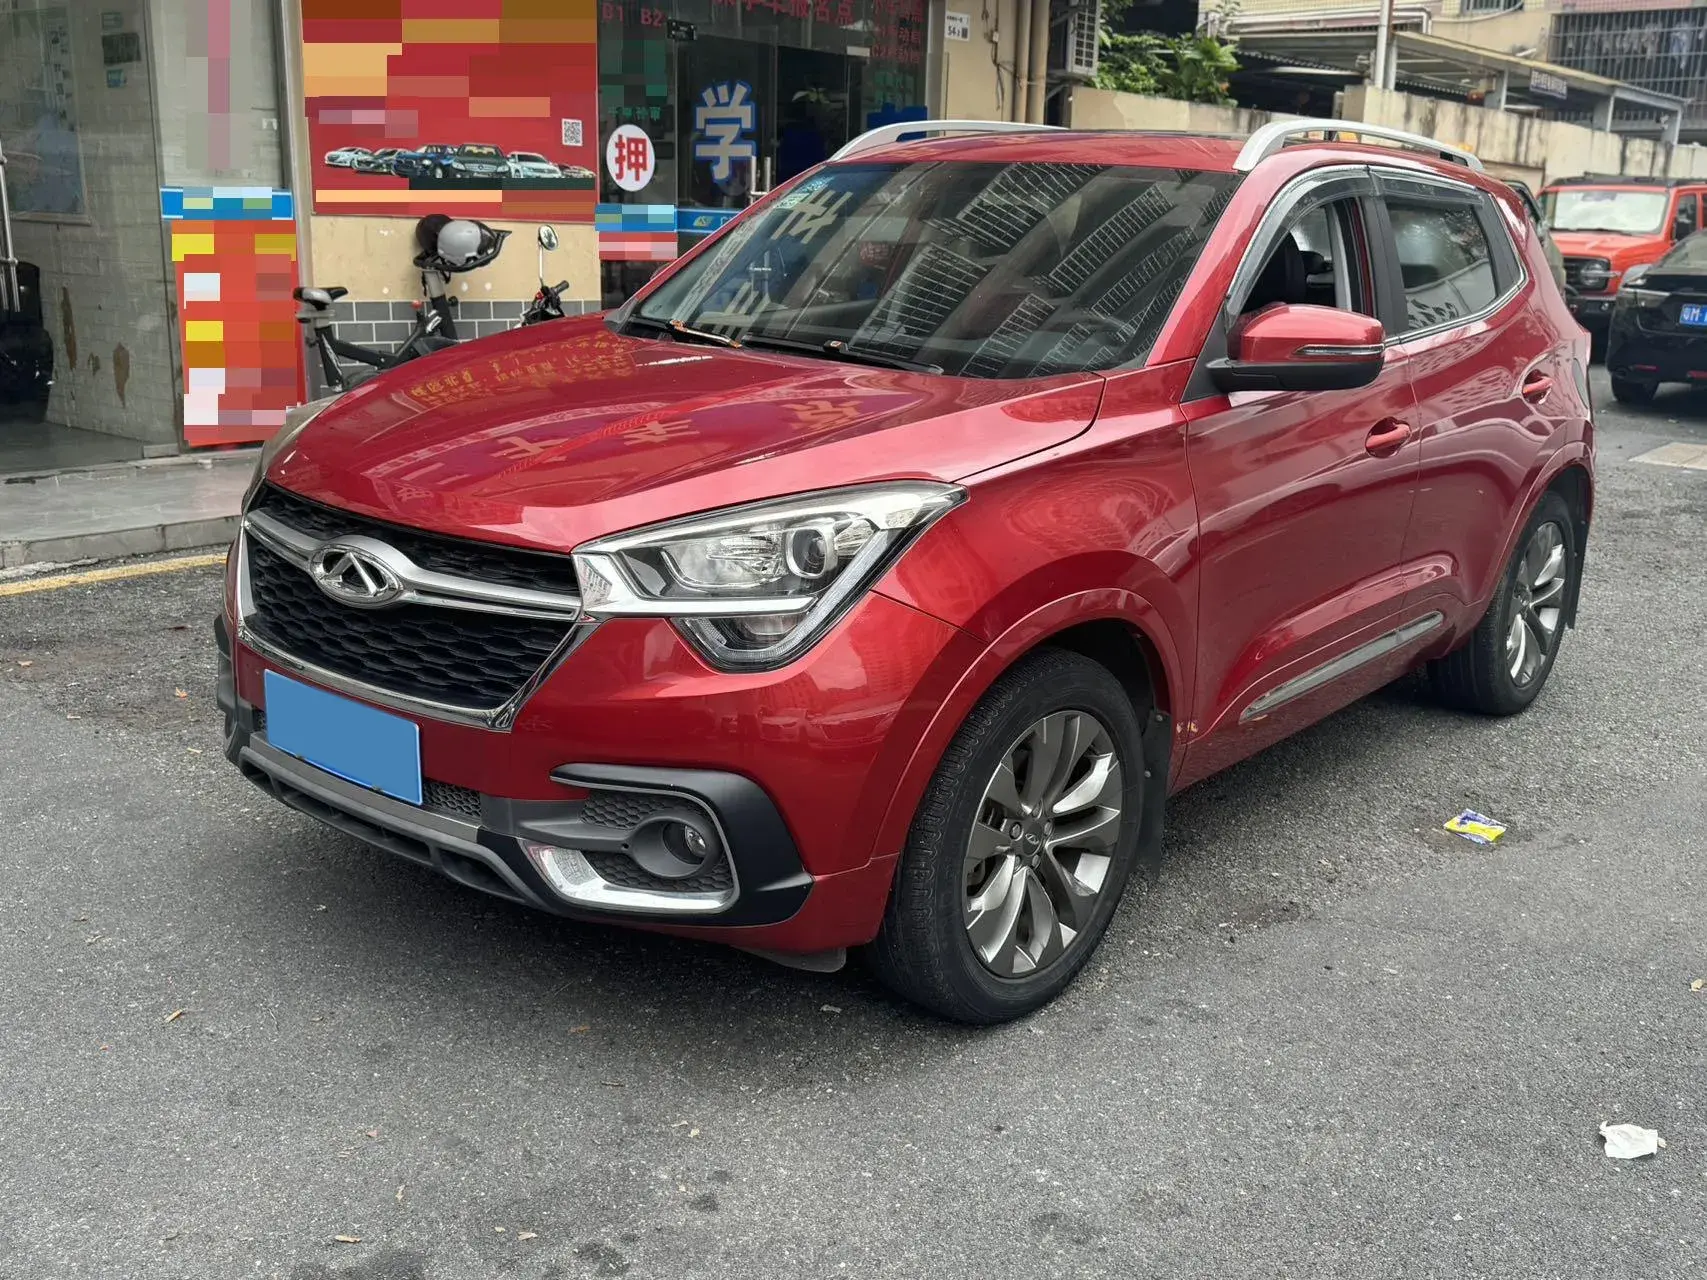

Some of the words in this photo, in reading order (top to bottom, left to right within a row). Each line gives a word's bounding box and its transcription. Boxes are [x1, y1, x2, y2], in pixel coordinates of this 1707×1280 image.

[641, 8, 662, 27] B2
[694, 80, 756, 185] 学
[614, 134, 648, 182] 押
